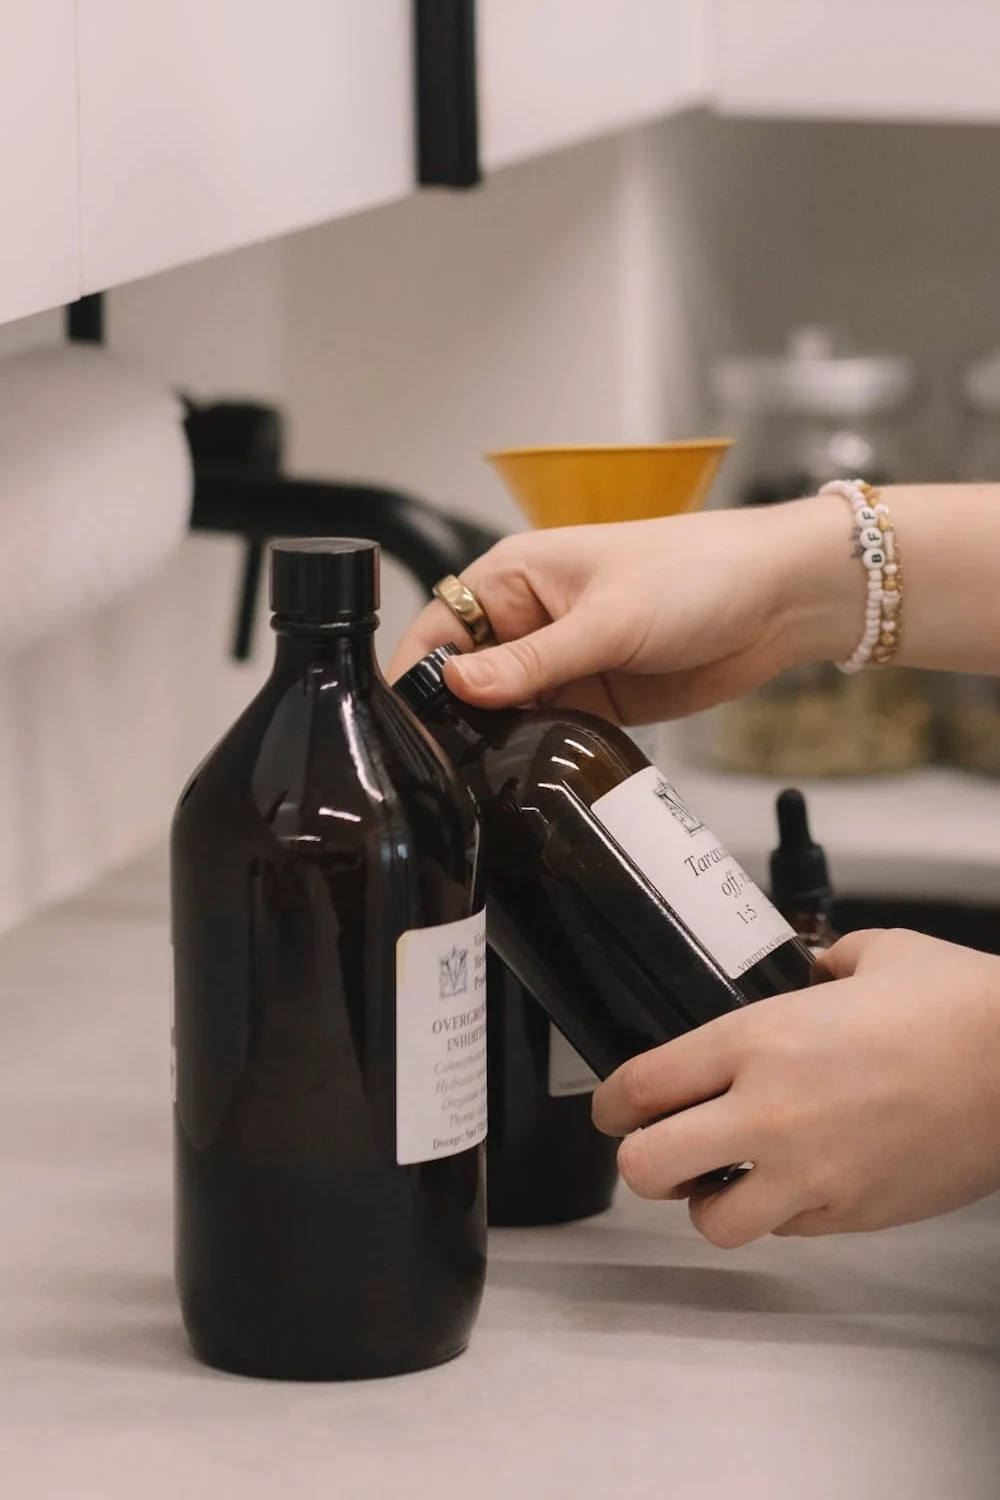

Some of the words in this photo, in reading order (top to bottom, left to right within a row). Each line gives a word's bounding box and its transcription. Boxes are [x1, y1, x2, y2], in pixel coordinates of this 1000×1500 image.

[862, 511, 883, 563] BFF
[721, 870, 744, 898] off.
[736, 903, 758, 925] 1:5
[737, 941, 776, 972] VIRIDITAS
